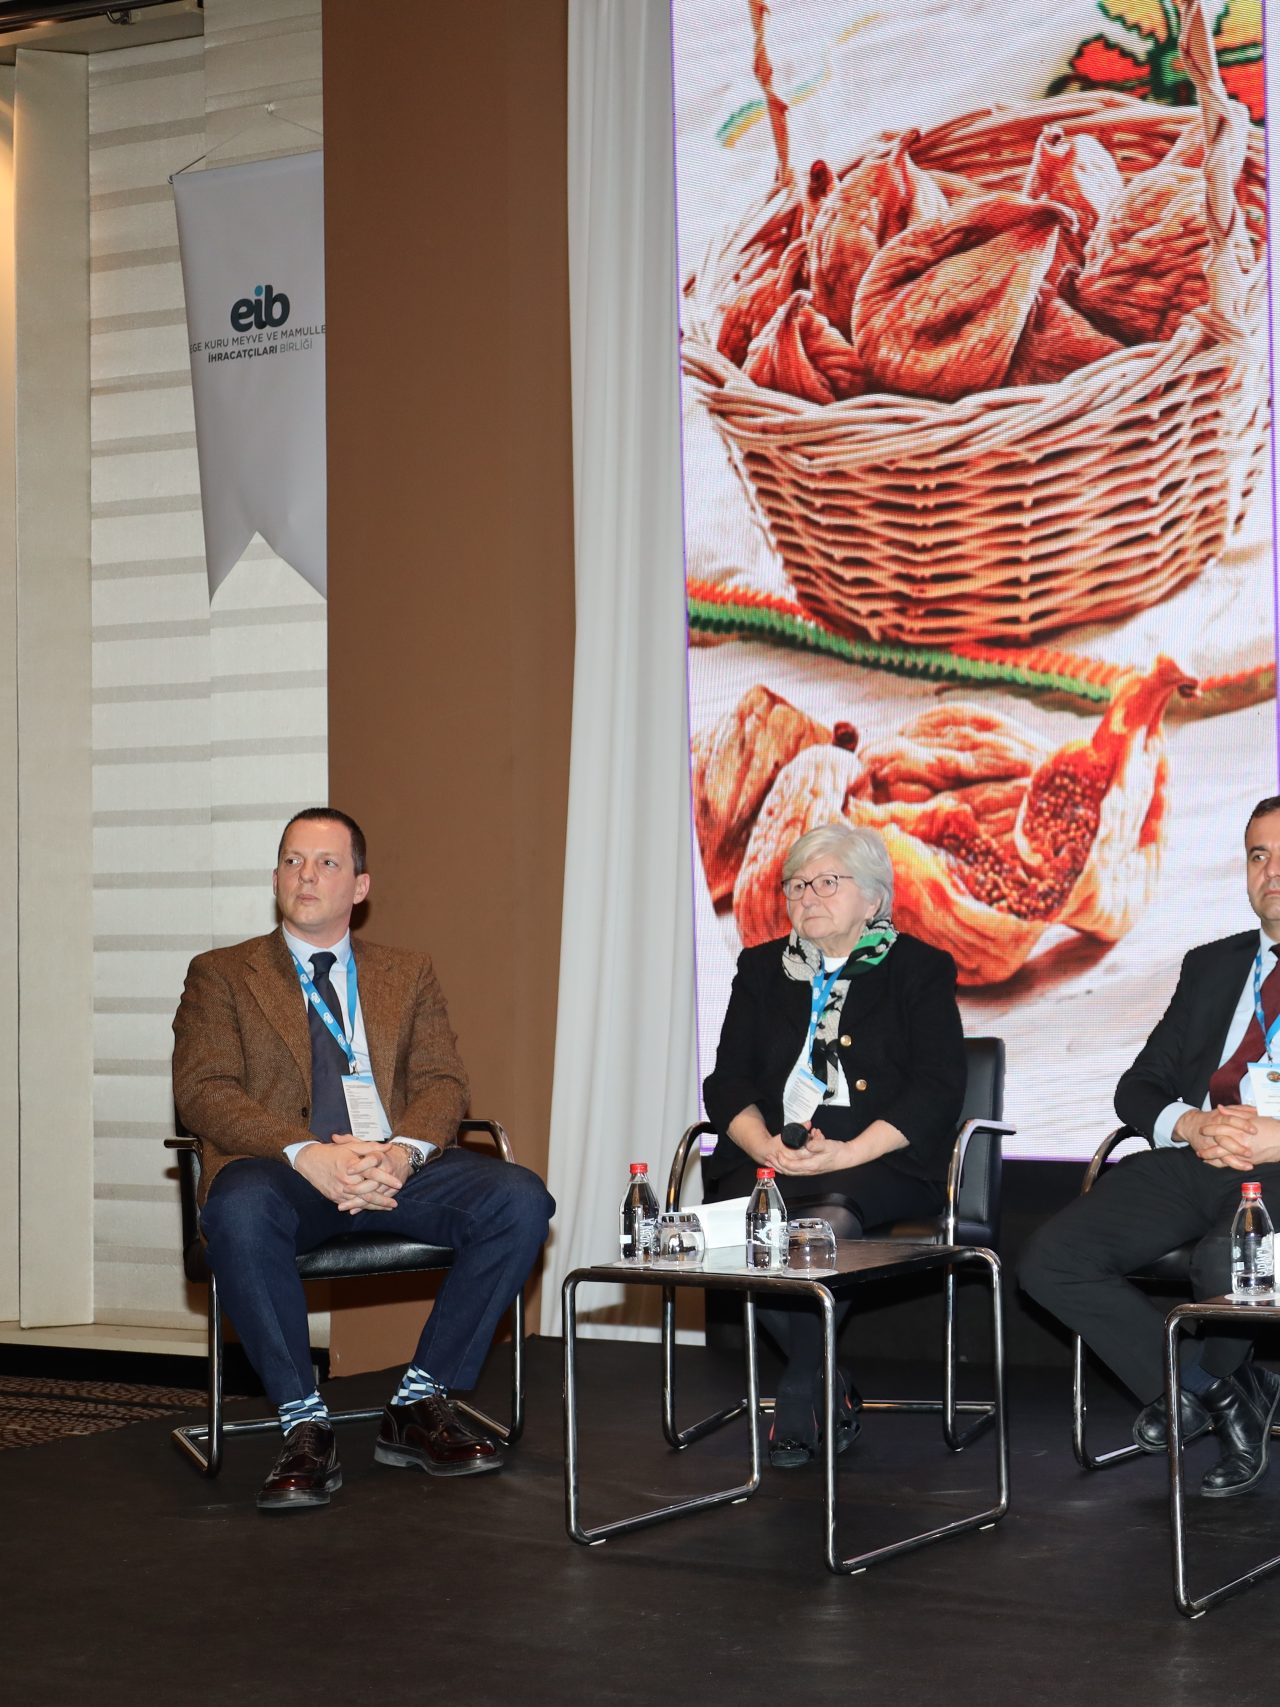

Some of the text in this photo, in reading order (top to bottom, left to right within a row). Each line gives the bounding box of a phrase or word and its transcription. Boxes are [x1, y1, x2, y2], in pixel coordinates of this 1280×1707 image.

[230, 284, 290, 332] eib
[204, 338, 229, 350] KURU
[232, 333, 264, 346] MEYVE
[266, 330, 278, 341] VE
[280, 324, 328, 339] MAMULLE
[208, 338, 313, 363] İHRACATÇILARI BİRLİĞİ
